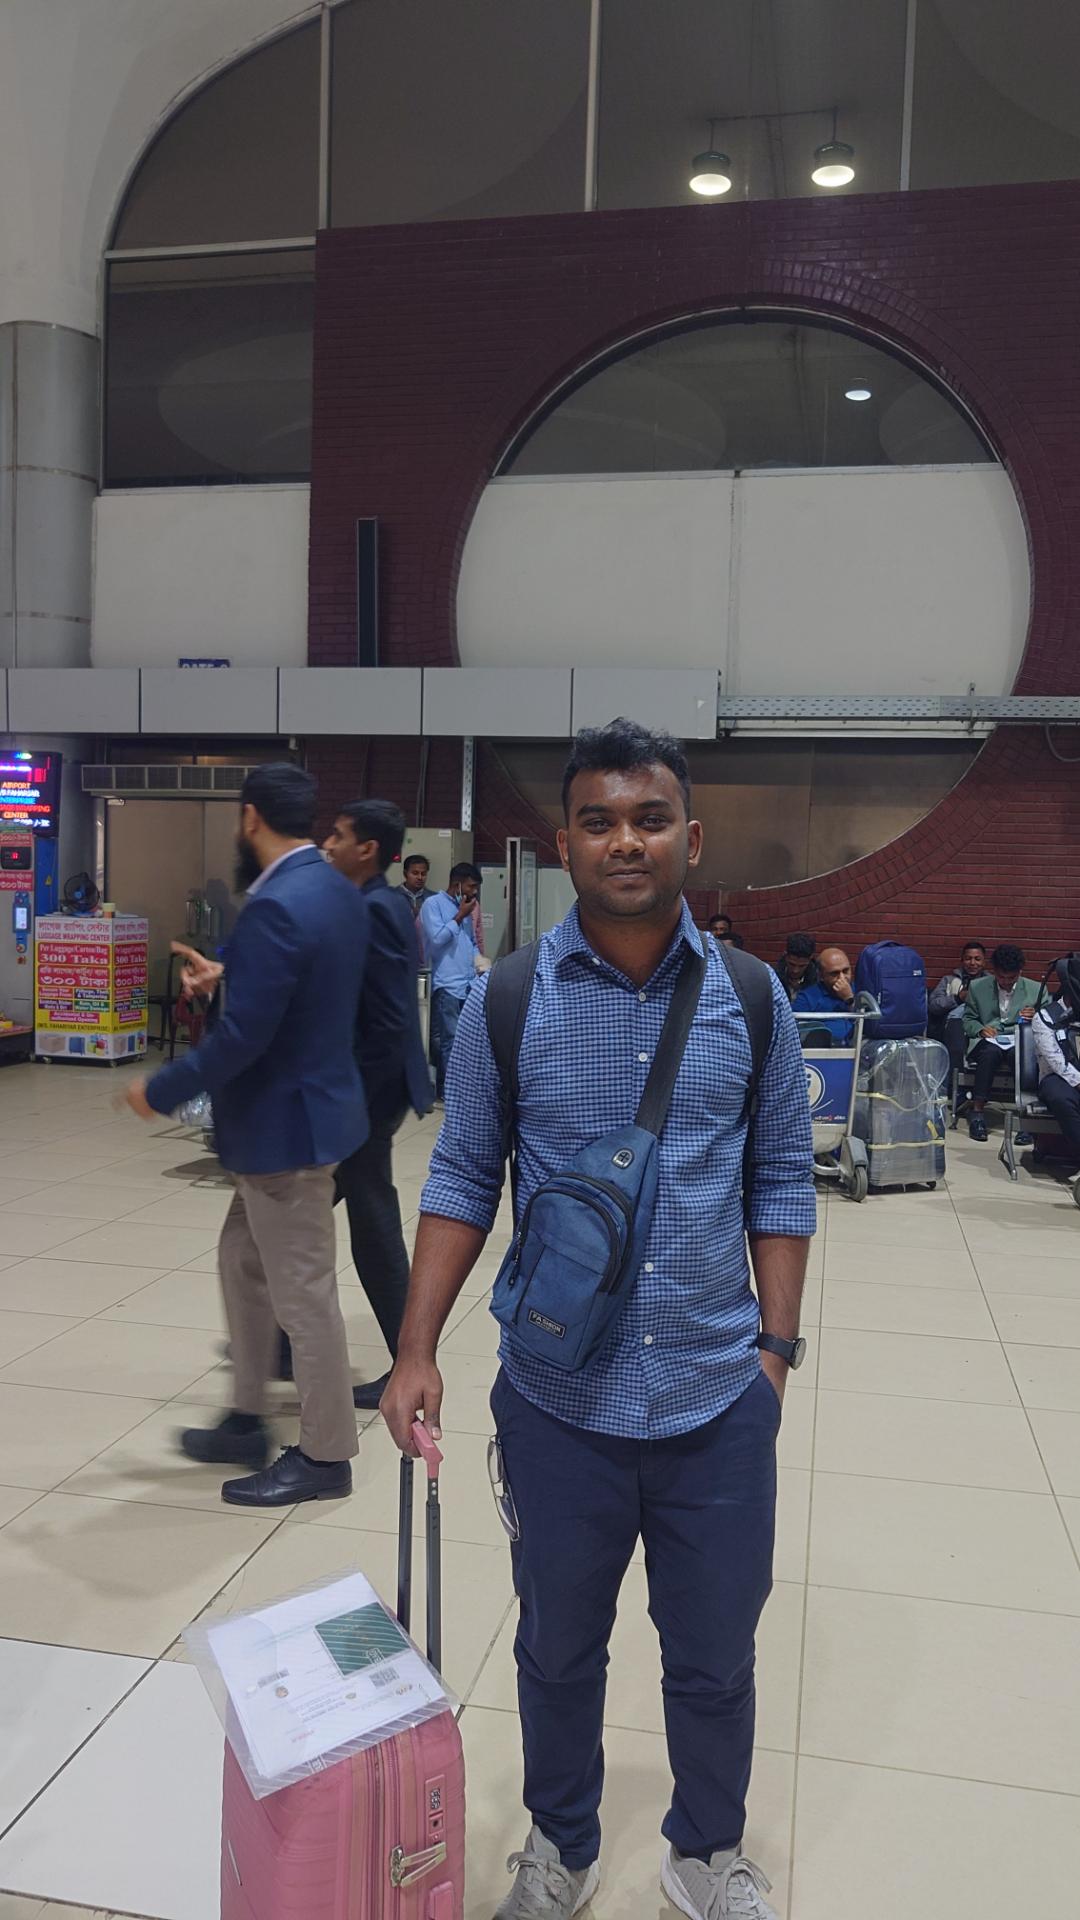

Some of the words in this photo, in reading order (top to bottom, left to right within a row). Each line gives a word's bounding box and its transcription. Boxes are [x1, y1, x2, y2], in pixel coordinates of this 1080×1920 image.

[3, 811, 29, 819] CENTER
[88, 934, 110, 942] CENTER
[40, 953, 67, 962] 300
[70, 955, 108, 964] Taka
[40, 976, 76, 985] ৩০০
[79, 976, 108, 988] টাকা
[531, 1312, 561, 1332] FASHION
